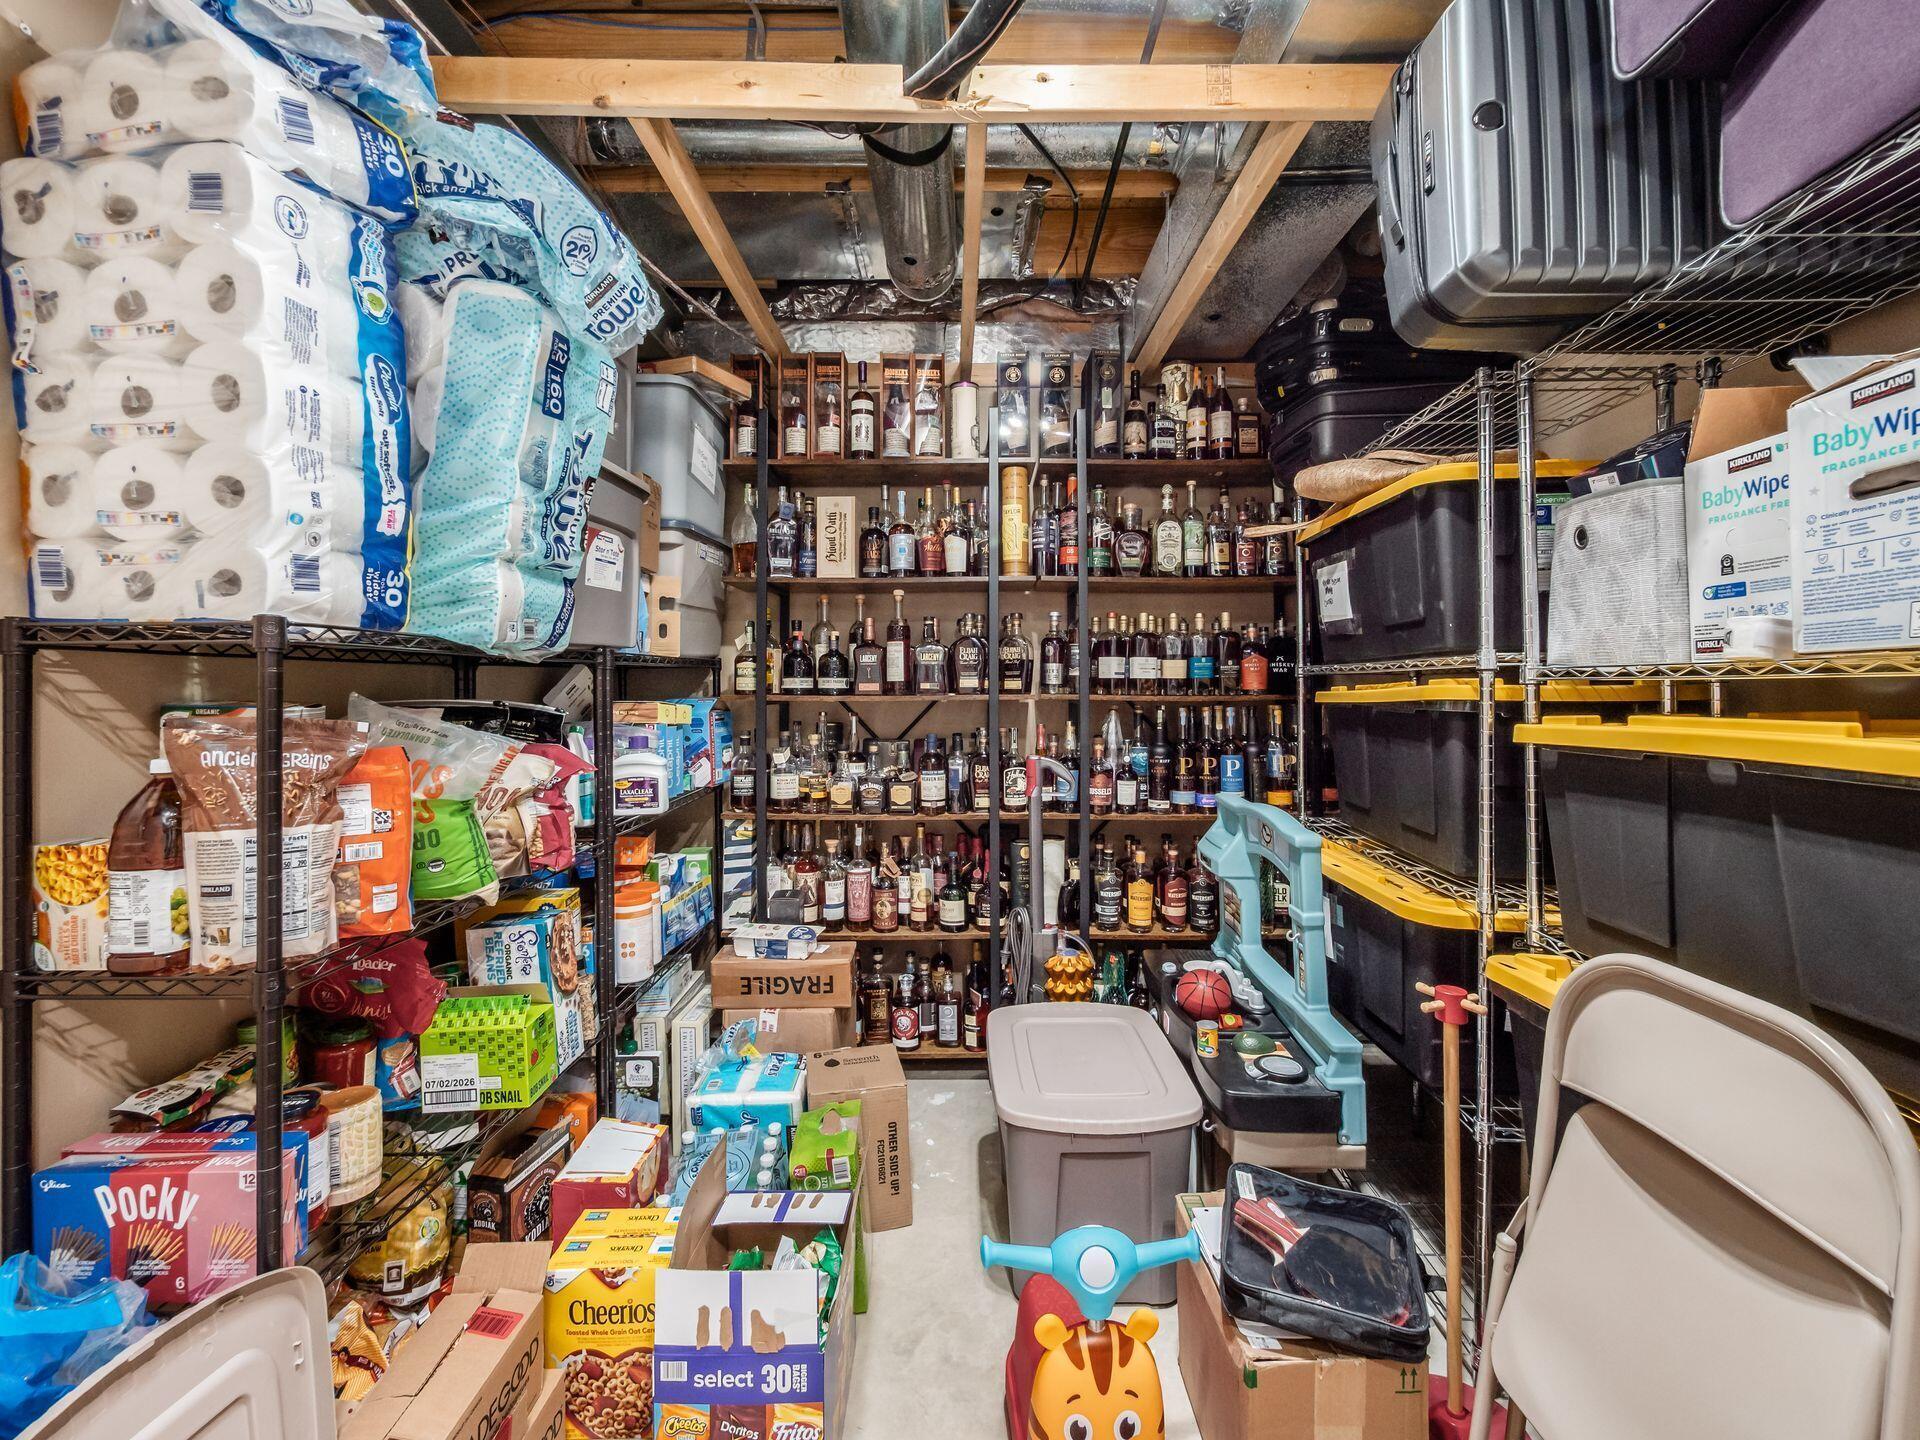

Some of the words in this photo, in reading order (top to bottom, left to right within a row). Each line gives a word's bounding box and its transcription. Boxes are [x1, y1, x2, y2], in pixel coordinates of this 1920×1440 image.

[378, 132, 404, 178] 30
[416, 183, 438, 194] hick
[443, 184, 466, 193] and
[585, 275, 614, 304] KIRKLAND
[592, 283, 629, 320] PREMIUM
[555, 342, 568, 365] 12
[378, 362, 400, 413] Charmin
[550, 373, 563, 415] 160
[1853, 372, 1915, 402] KIRKLAND
[1729, 449, 1771, 469] KIRKLAND
[1821, 443, 1908, 475] FRAGRANCE
[1702, 474, 1789, 510] BabyWipe
[1708, 503, 1767, 525] FRAGRANCE
[1770, 499, 1790, 513] FRE
[1851, 504, 1877, 514] Proven
[825, 511, 837, 534] Oath
[385, 570, 405, 608] 30
[1696, 639, 1725, 649] KIRKLA
[1179, 757, 1194, 775] P
[1203, 757, 1217, 775] P
[1226, 759, 1240, 777] P
[484, 937, 496, 981] BEANS
[493, 931, 506, 985] REFRIED
[504, 943, 513, 980] ORGANIC
[740, 975, 834, 996] FRAGILE
[425, 1078, 475, 1089] 07/02/2026
[480, 1092, 493, 1104] OB
[495, 1090, 522, 1103] SNAIL
[888, 1121, 897, 1150] OTHER
[890, 1155, 899, 1177] SIDE
[40, 1180, 72, 1192] Glico
[242, 1174, 256, 1185] 12
[891, 1180, 900, 1196] UP!
[93, 1177, 200, 1231] Pocky
[473, 1220, 496, 1231] KODIAK
[525, 1217, 551, 1243] KODIA
[175, 1277, 185, 1289] 6
[569, 1299, 655, 1325] Cheerios
[610, 1328, 627, 1336] Grain
[471, 1336, 540, 1440] DEGOOD
[693, 1370, 754, 1388] select
[761, 1364, 792, 1394] 30
[665, 1417, 707, 1434] Cheetos
[720, 1421, 760, 1440] Doritos
